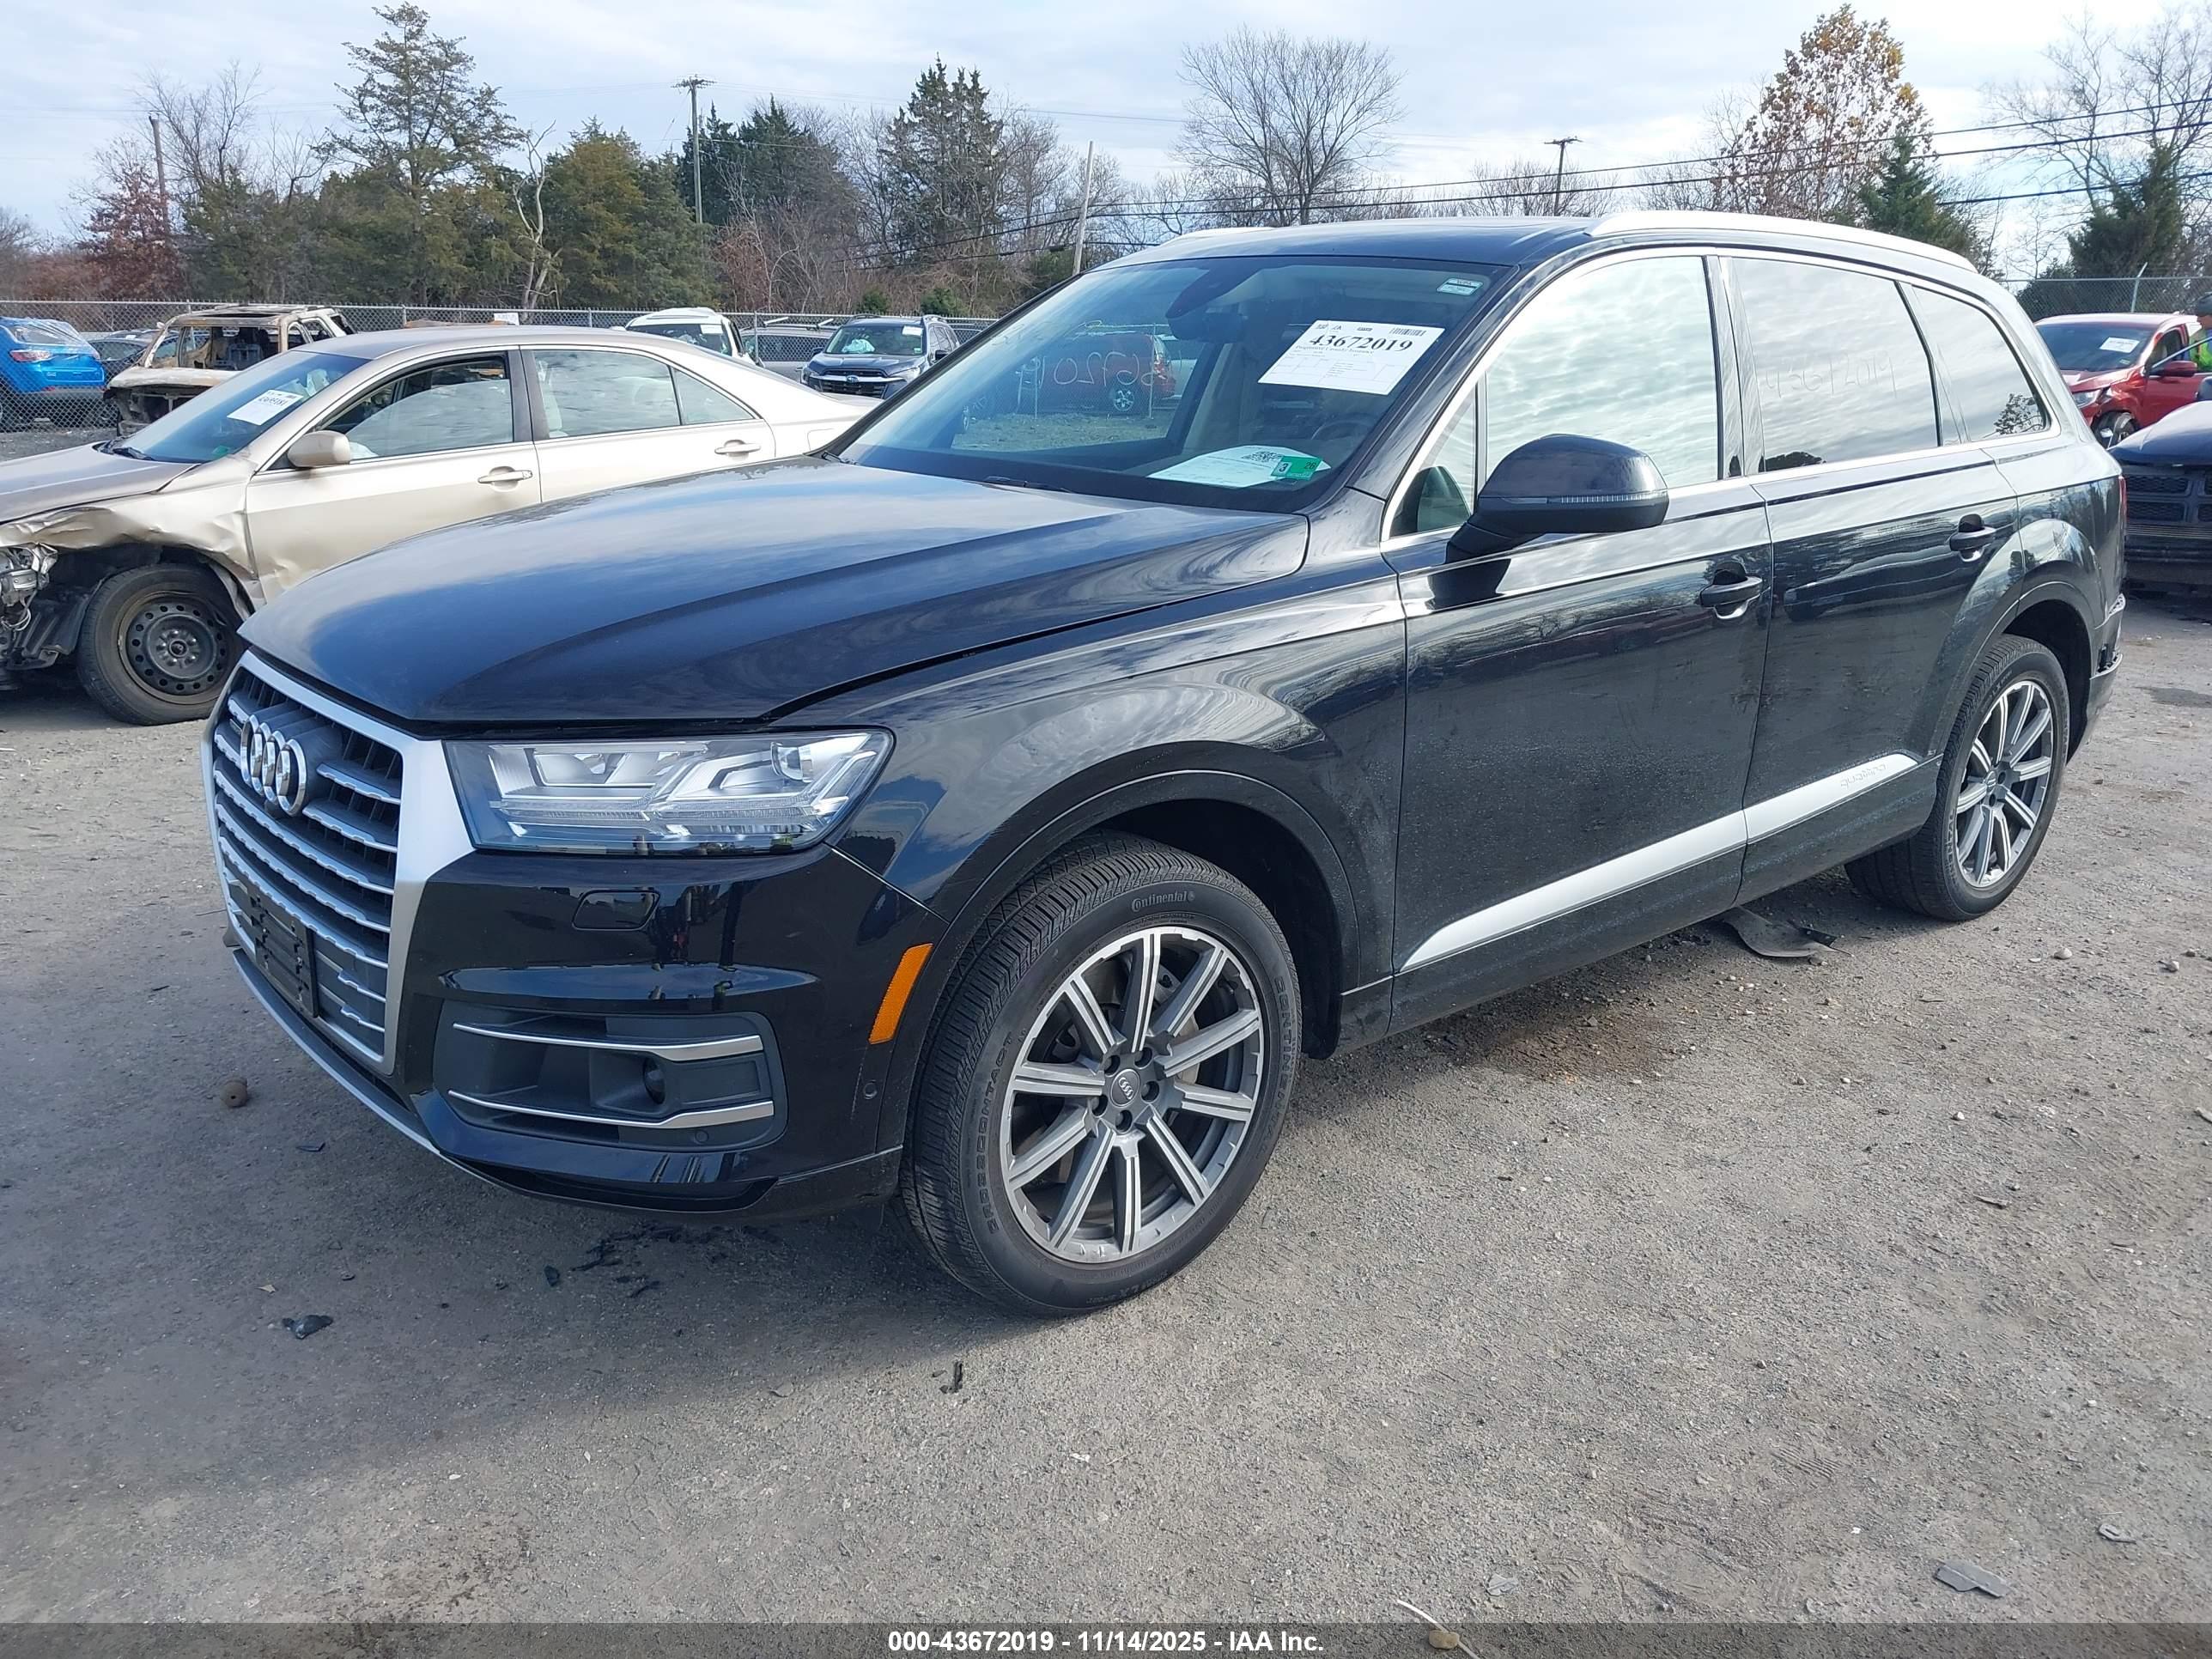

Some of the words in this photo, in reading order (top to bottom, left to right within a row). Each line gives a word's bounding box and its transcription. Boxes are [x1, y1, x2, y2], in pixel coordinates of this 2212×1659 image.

[1309, 334, 1413, 352] 43672019
[1279, 463, 1288, 471] 3
[1131, 890, 1188, 912] Continental
[976, 1031, 1014, 1234] CROSSCONTACT
